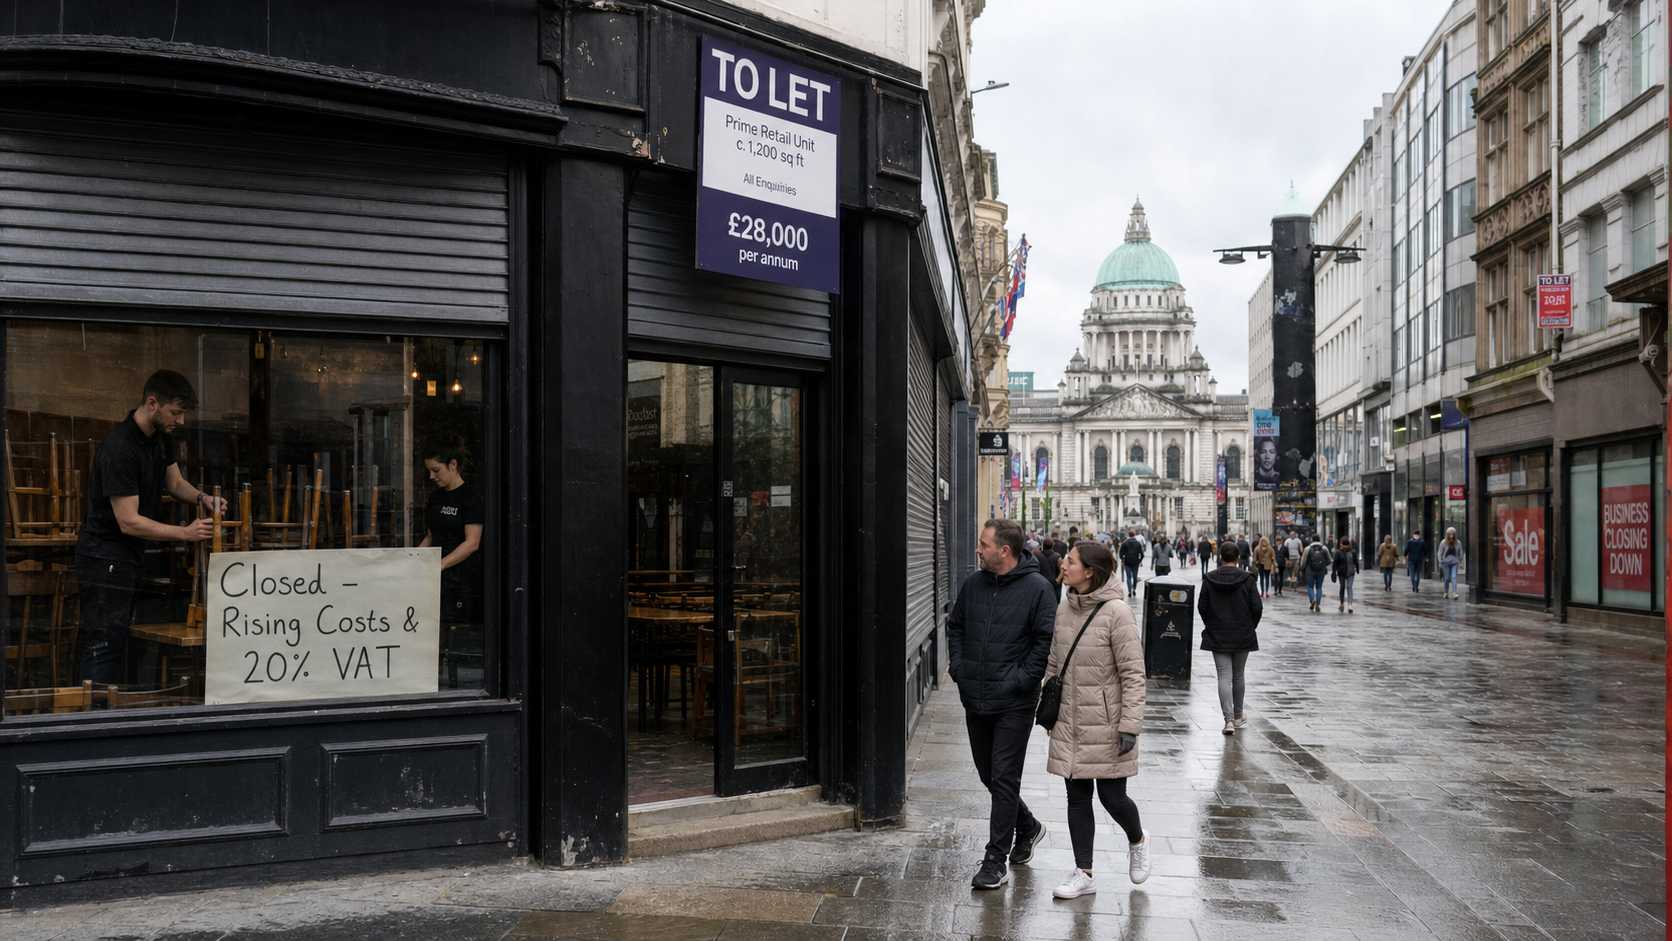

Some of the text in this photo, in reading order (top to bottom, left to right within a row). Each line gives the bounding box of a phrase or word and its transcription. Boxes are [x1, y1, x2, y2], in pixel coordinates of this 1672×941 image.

[712, 48, 831, 122] TO LET
[725, 114, 815, 152] Prime Retail Unit
[736, 139, 805, 168] c. 1,200 sq ft
[743, 173, 755, 186] All
[728, 212, 809, 252] £28,000
[739, 248, 799, 271] per annum
[1540, 276, 1570, 285] TO LET
[1604, 502, 1649, 524] BUSINESS
[1503, 519, 1539, 567] Sale
[1605, 528, 1648, 549] CLOSING
[220, 562, 327, 597] Closed
[1610, 553, 1643, 576] DOWN
[223, 604, 419, 647] Rising Costs &
[244, 645, 401, 684] 20% VAT
